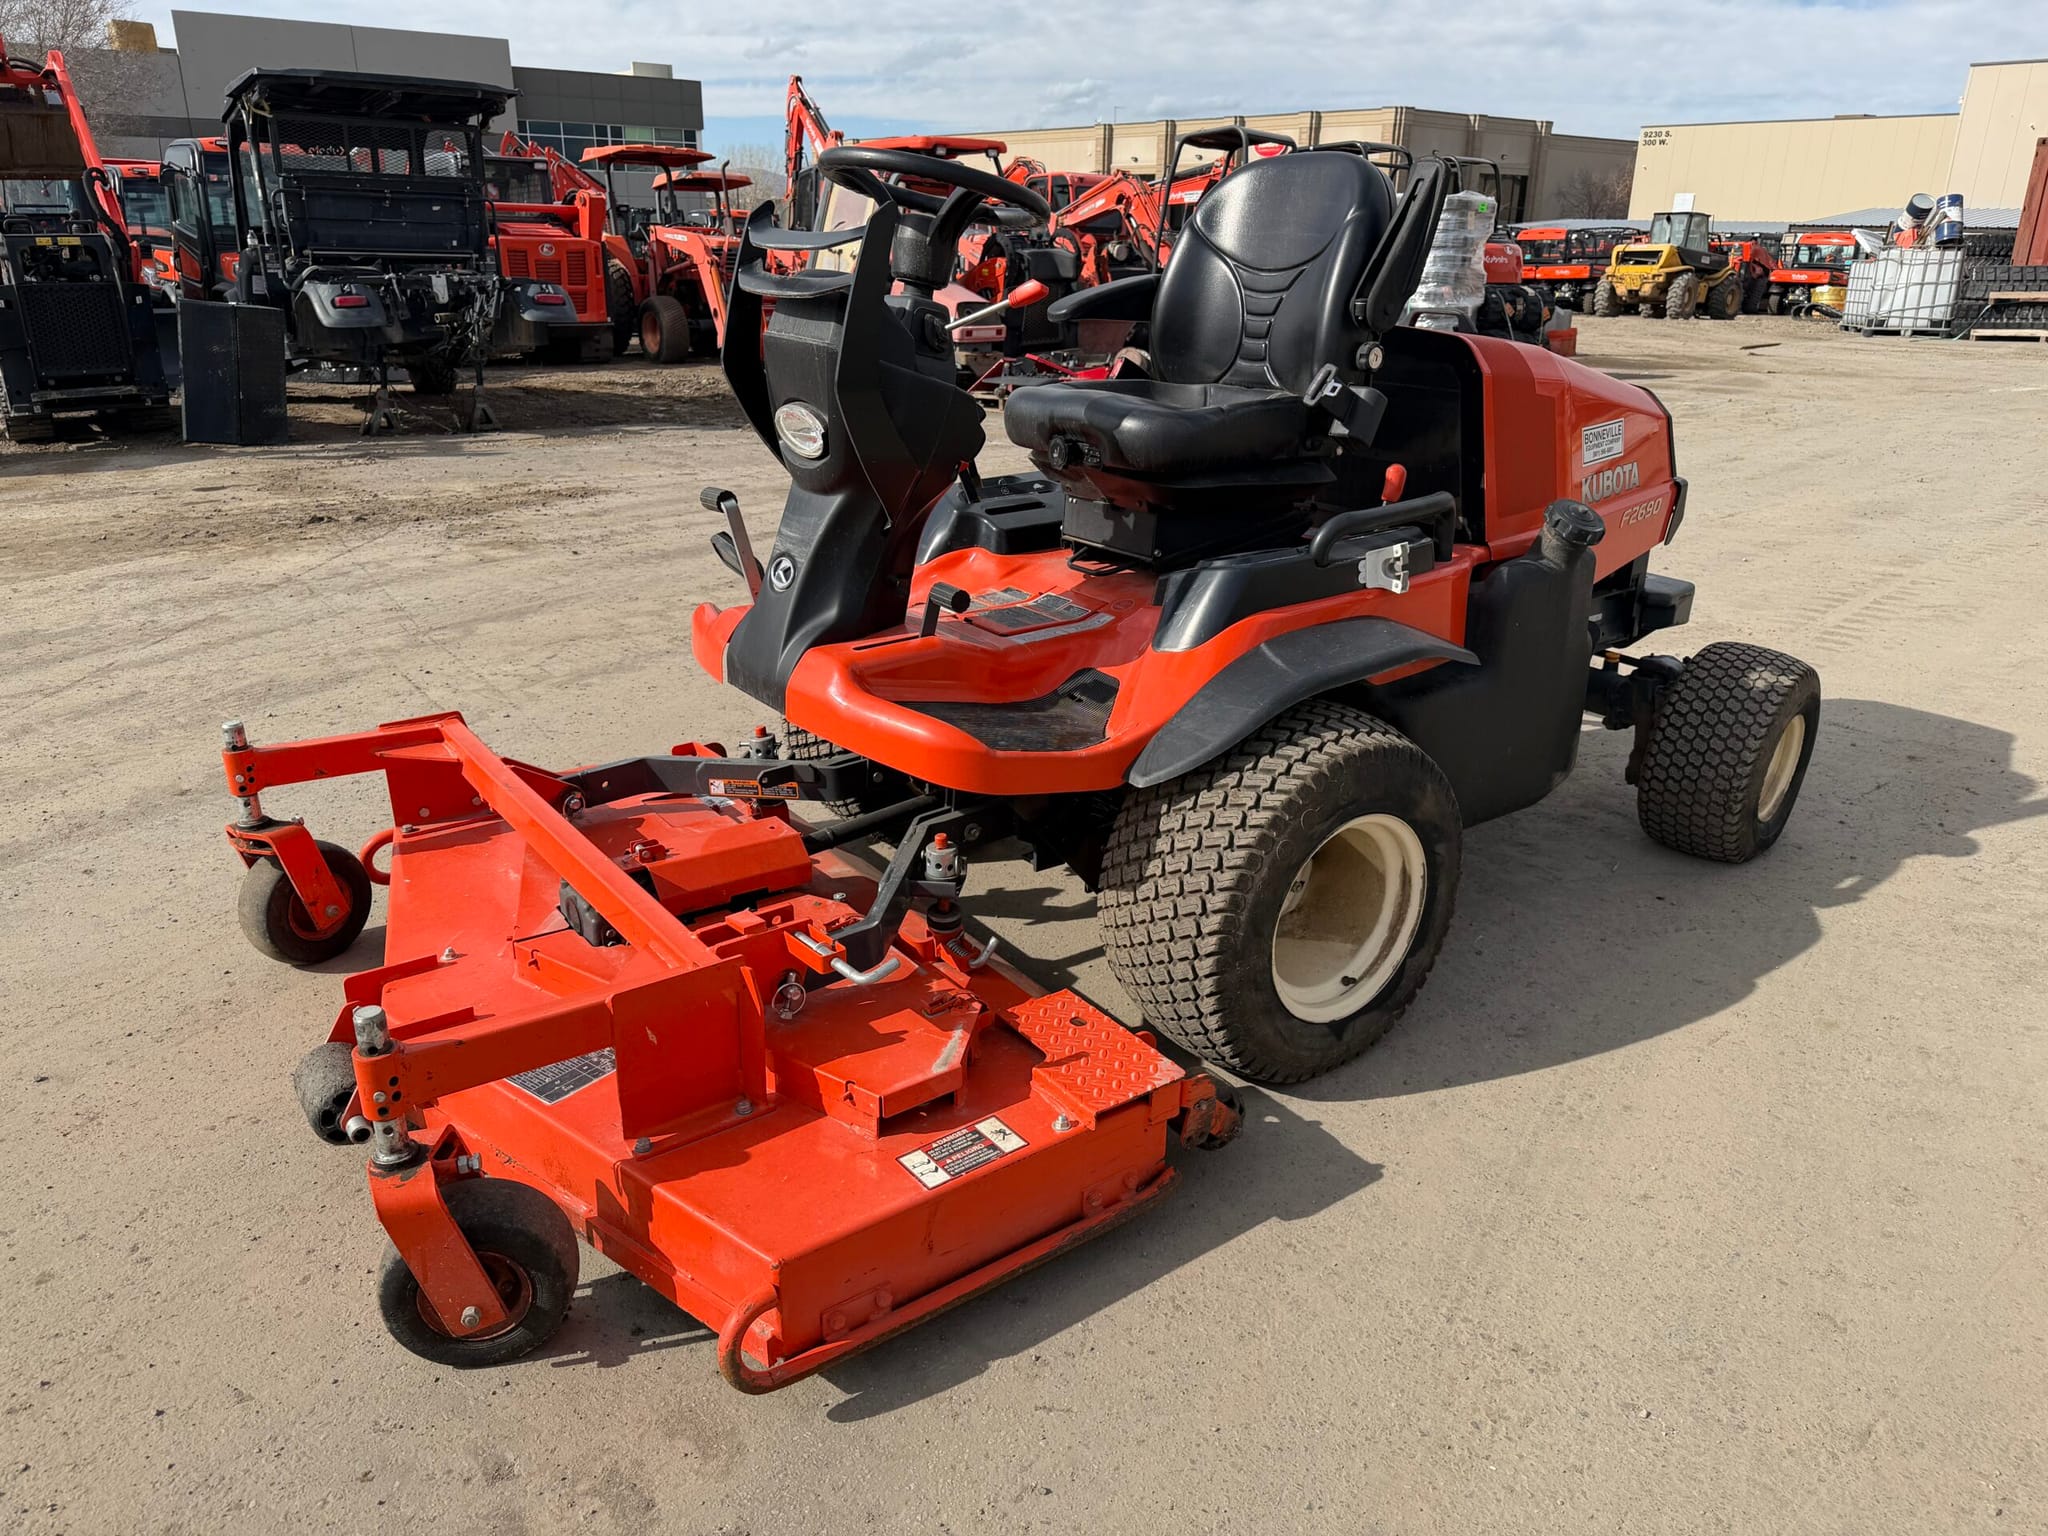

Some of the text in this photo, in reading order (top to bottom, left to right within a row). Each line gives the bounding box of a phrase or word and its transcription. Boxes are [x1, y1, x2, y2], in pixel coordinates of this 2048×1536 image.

[1643, 130, 1673, 138] 9230 S.
[1658, 138, 1669, 146] W.
[1585, 425, 1622, 445] BONNEVILLE
[1583, 462, 1639, 505] KUBOTA
[1620, 498, 1663, 529] F2690
[937, 1129, 969, 1145] DANGER
[951, 1143, 985, 1160] PELIGRO
